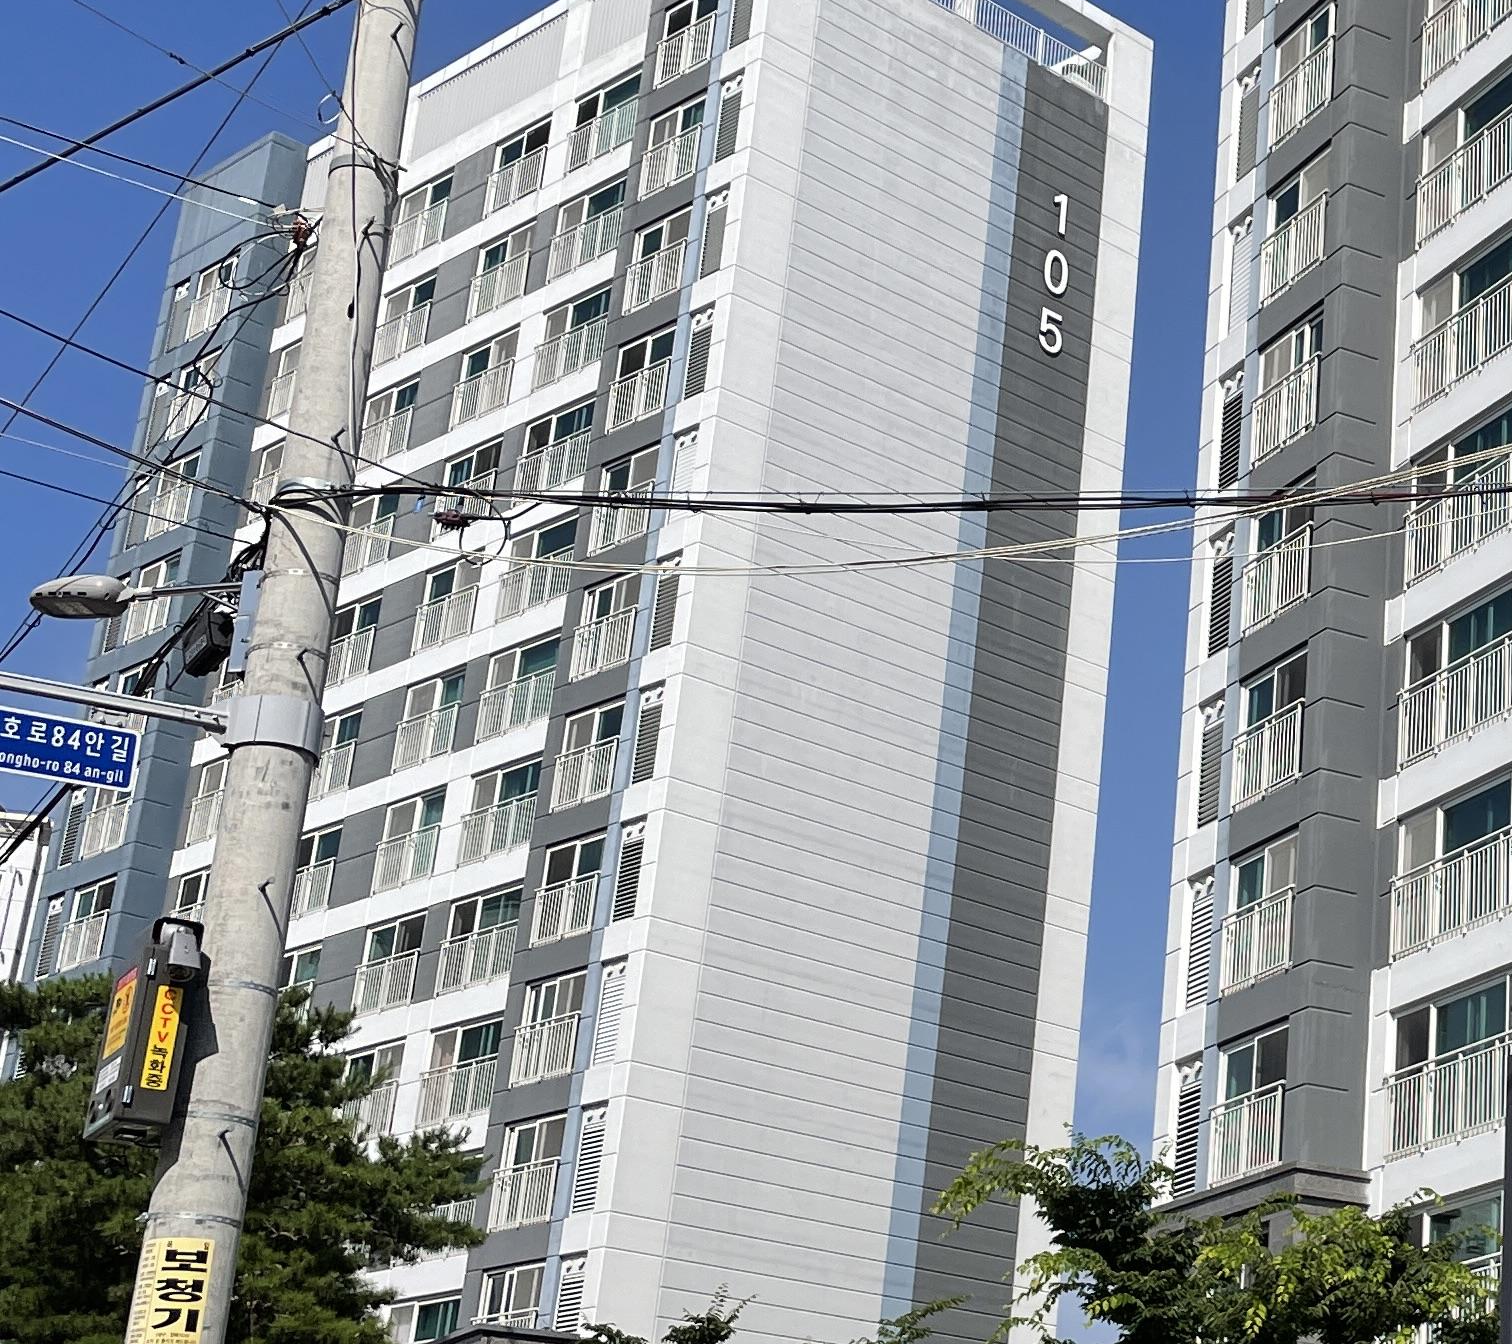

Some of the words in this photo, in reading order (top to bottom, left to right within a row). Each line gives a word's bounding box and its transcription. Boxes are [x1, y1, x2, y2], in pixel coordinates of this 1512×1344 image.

[1039, 193, 1069, 354] 105
[64, 761, 81, 774] 84
[84, 766, 124, 783] an-gil
[157, 988, 177, 1043] CCTV
[146, 1044, 168, 1088] 녹화중
[152, 1249, 208, 1333] 보청기
